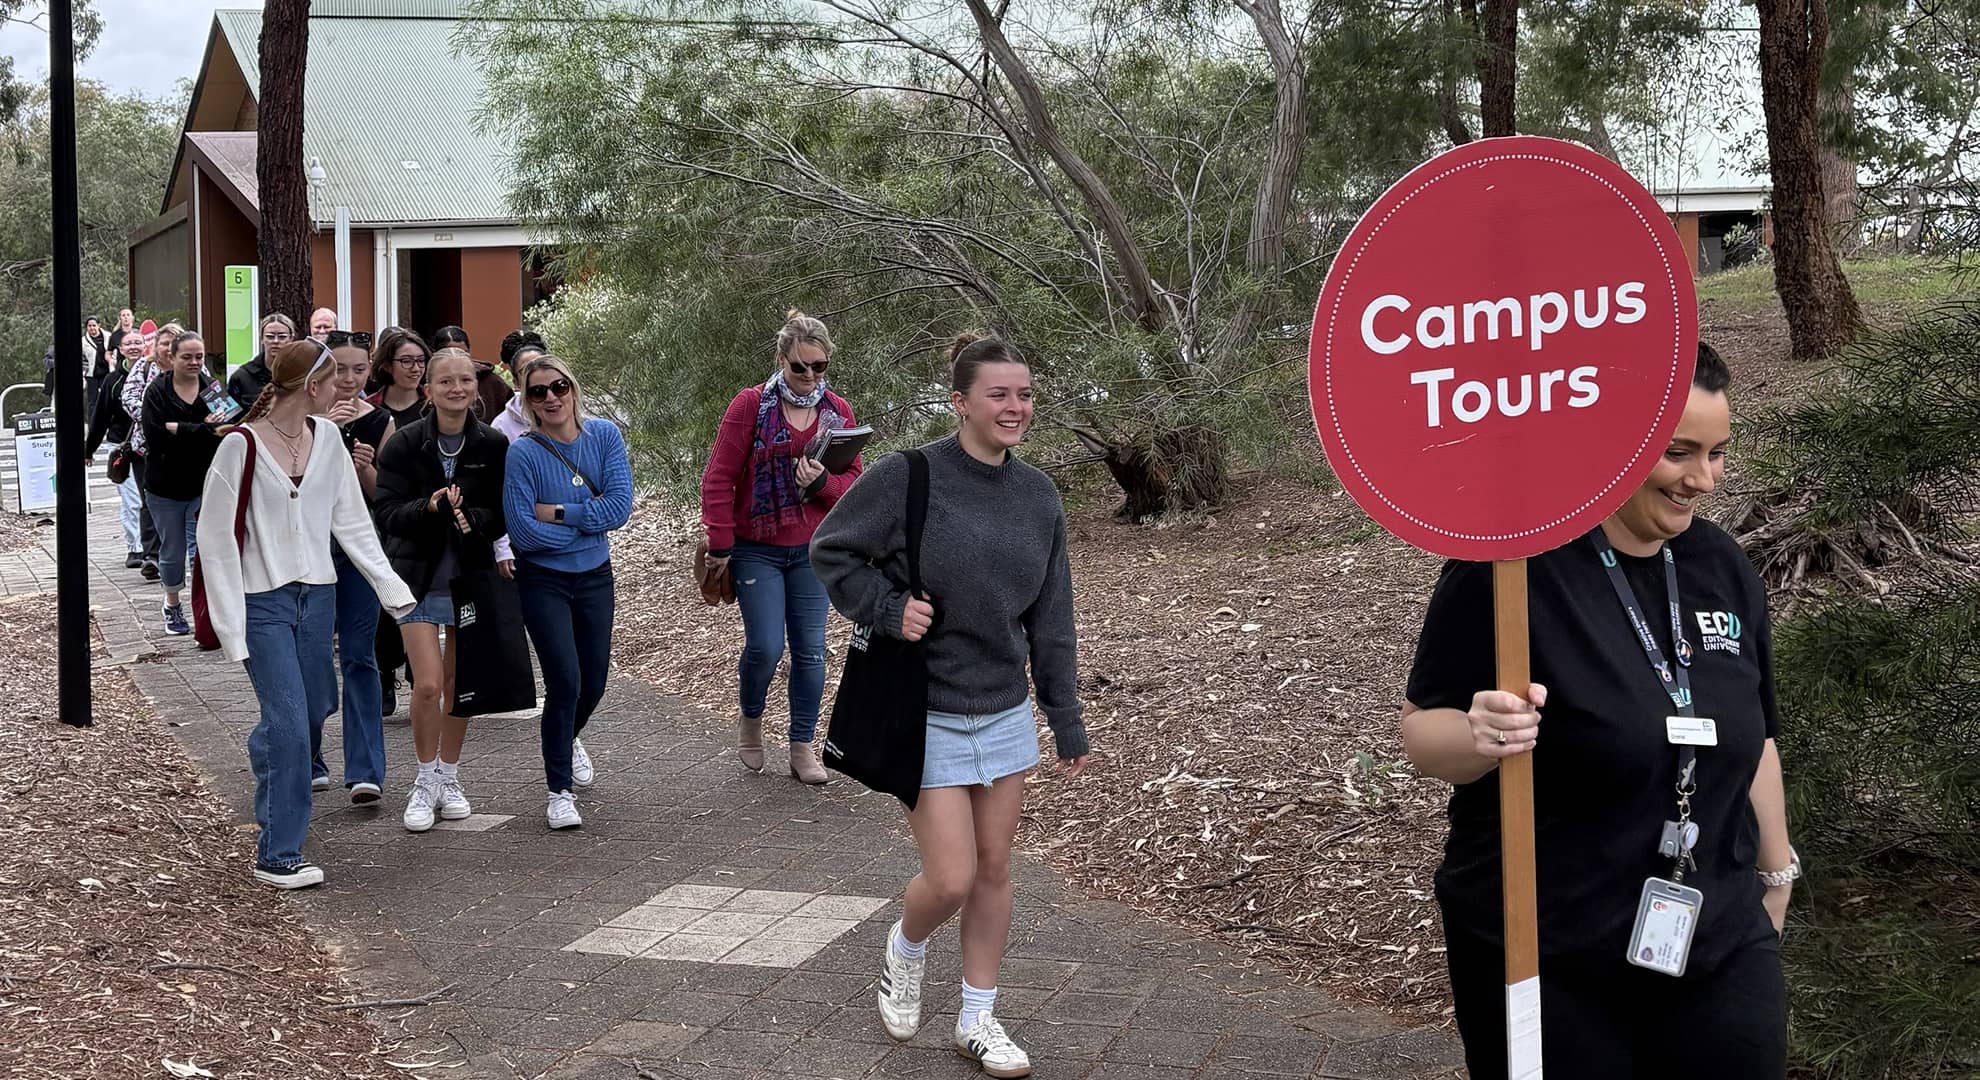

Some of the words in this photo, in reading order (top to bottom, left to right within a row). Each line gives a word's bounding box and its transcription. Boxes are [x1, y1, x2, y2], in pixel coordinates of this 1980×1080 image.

[235, 271, 242, 284] 6
[1360, 281, 1647, 355] Campus
[1410, 365, 1600, 427] Tours
[460, 601, 476, 620] ECU
[1694, 611, 1741, 640] ECU
